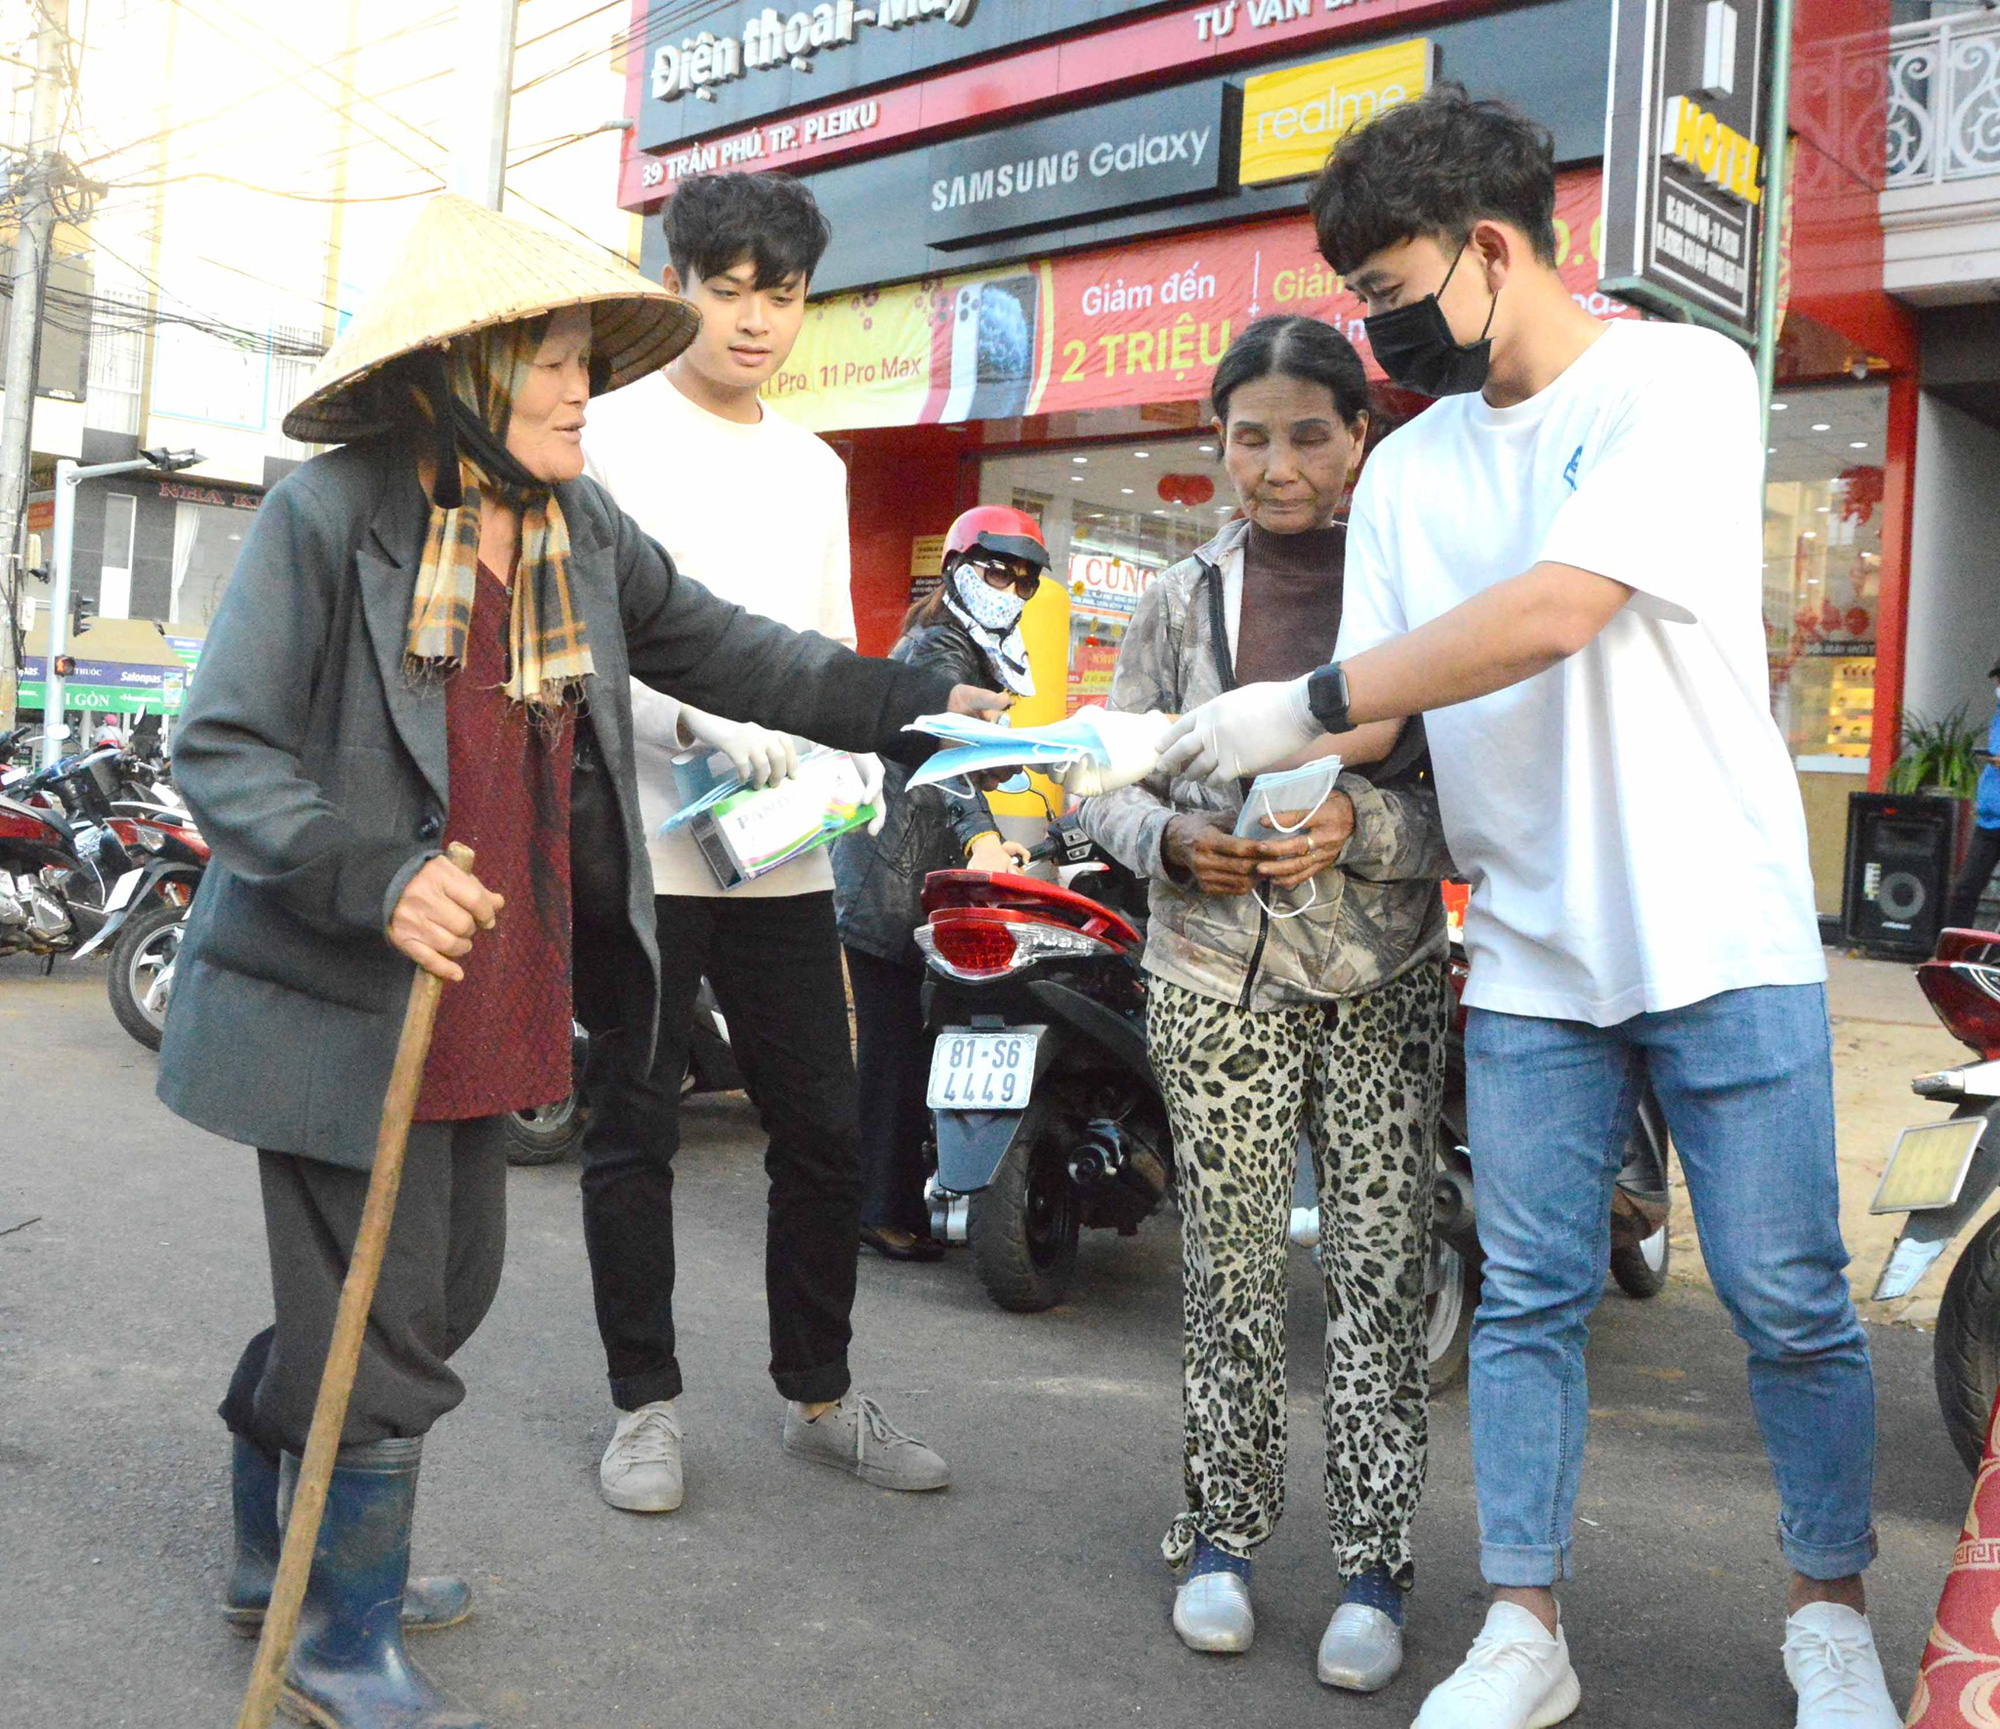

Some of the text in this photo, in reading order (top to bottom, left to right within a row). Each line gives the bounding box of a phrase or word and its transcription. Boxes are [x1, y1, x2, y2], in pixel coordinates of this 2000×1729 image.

[651, 31, 741, 101] Điện
[642, 162, 664, 188] 39
[804, 101, 879, 144] PLEIKU
[1257, 84, 1407, 144] realme
[931, 125, 1212, 212] SAMSUNG Galaxy
[1668, 95, 1761, 206] HOTEL
[1082, 260, 1216, 316] Giảm đến
[778, 371, 808, 395] Pro
[820, 364, 839, 388] 11
[844, 362, 876, 386] Pro
[881, 355, 923, 381] Max
[1061, 311, 1232, 384] 2 TRIỆU
[943, 1072, 1017, 1103] 4449
